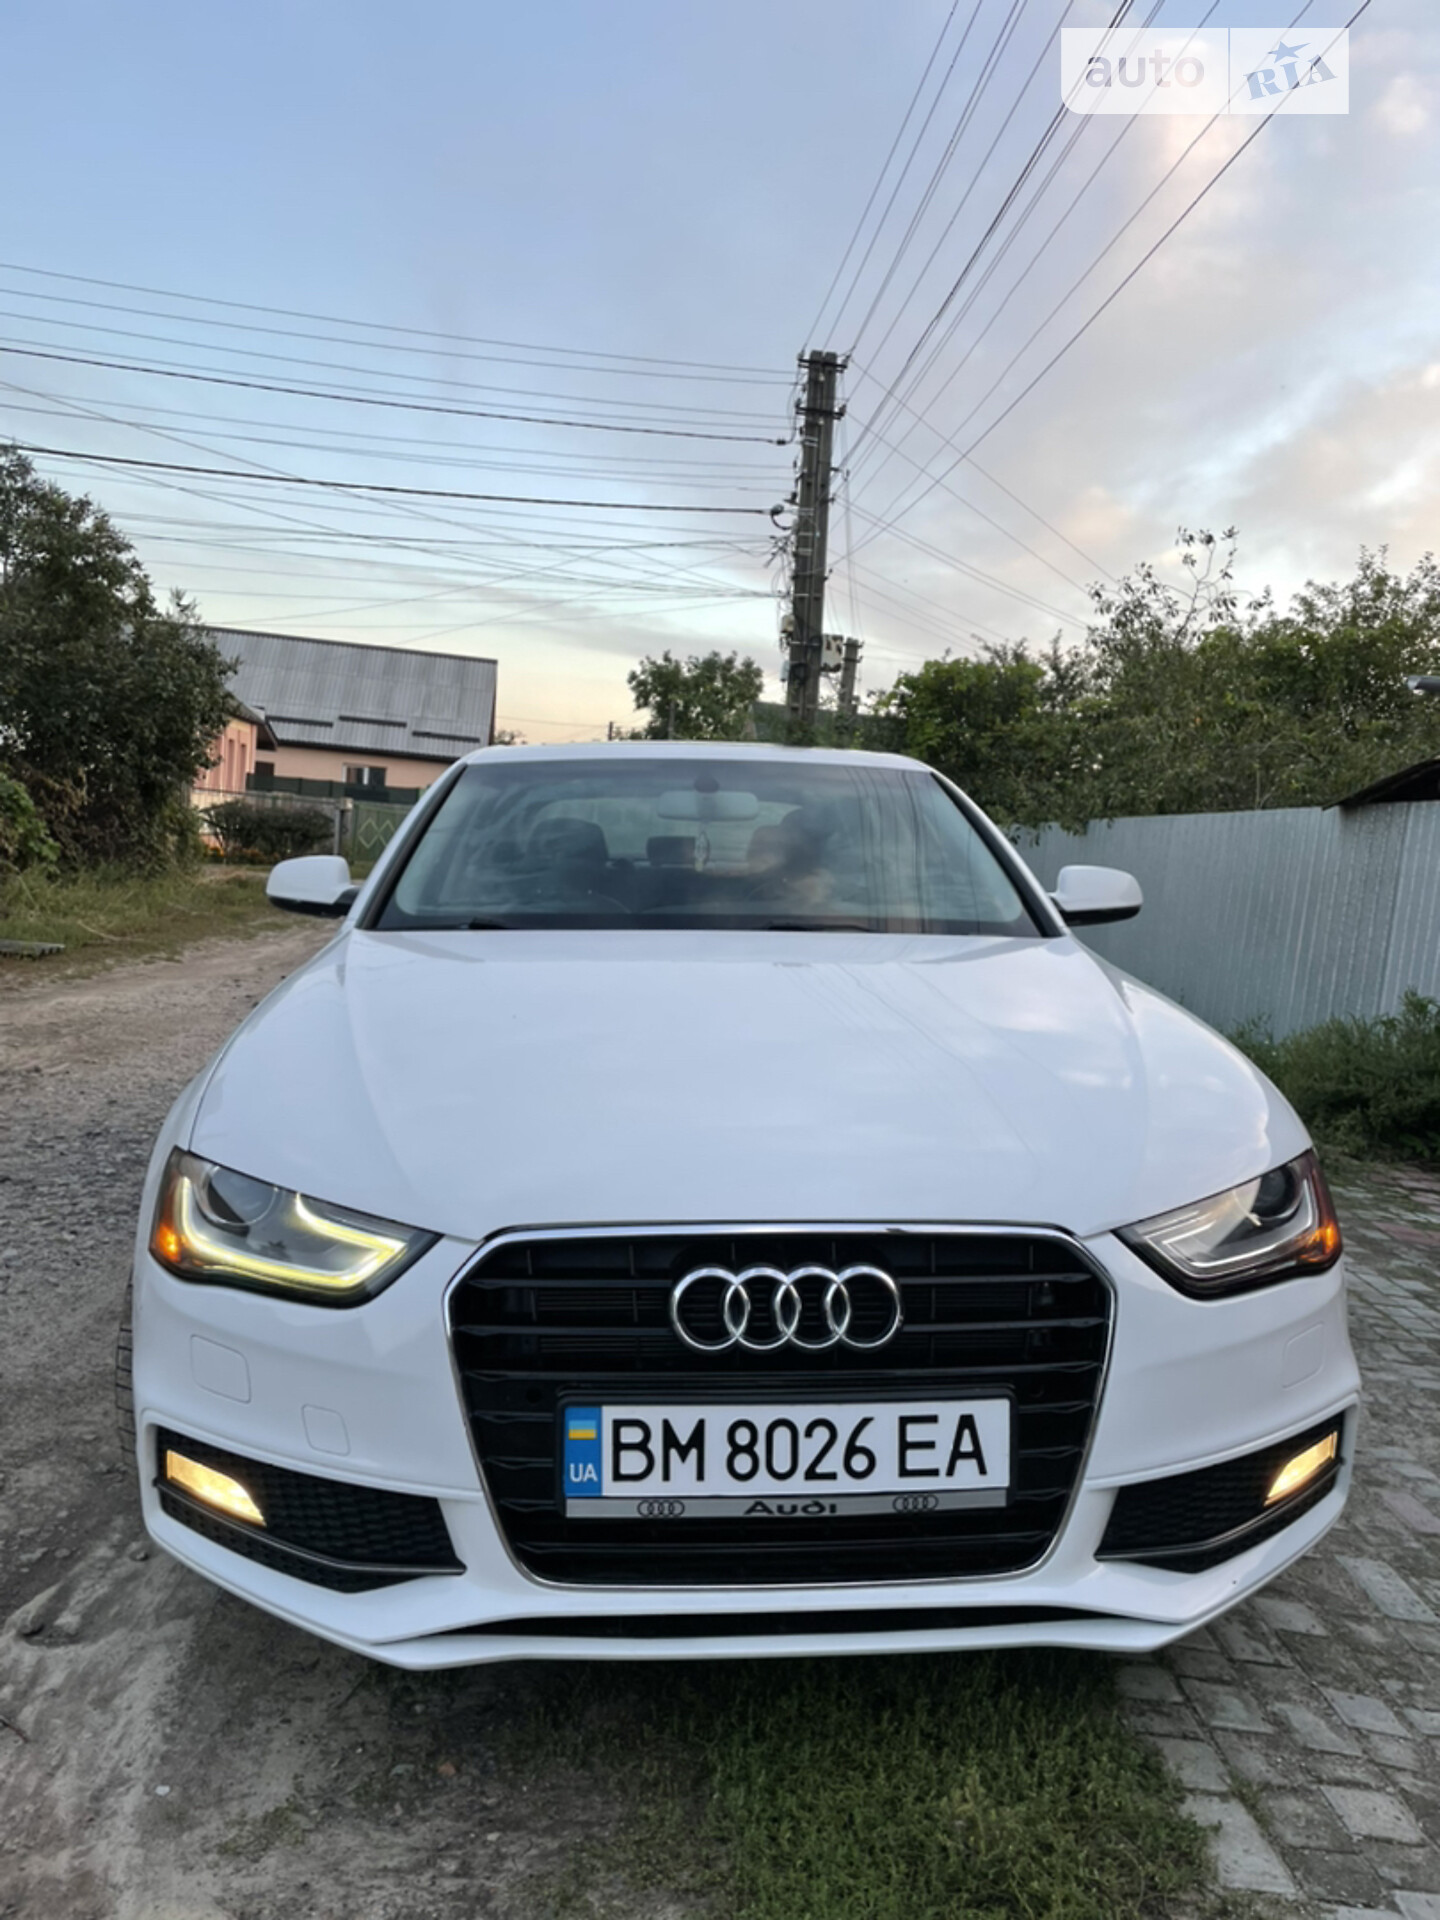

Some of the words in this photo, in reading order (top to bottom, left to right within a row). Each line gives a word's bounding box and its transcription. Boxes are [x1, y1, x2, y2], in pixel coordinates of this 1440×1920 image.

[612, 1418, 705, 1482] BM
[725, 1417, 876, 1481] 8026
[898, 1414, 987, 1478] EA
[570, 1464, 598, 1483] UA
[743, 1500, 837, 1516] Audi
